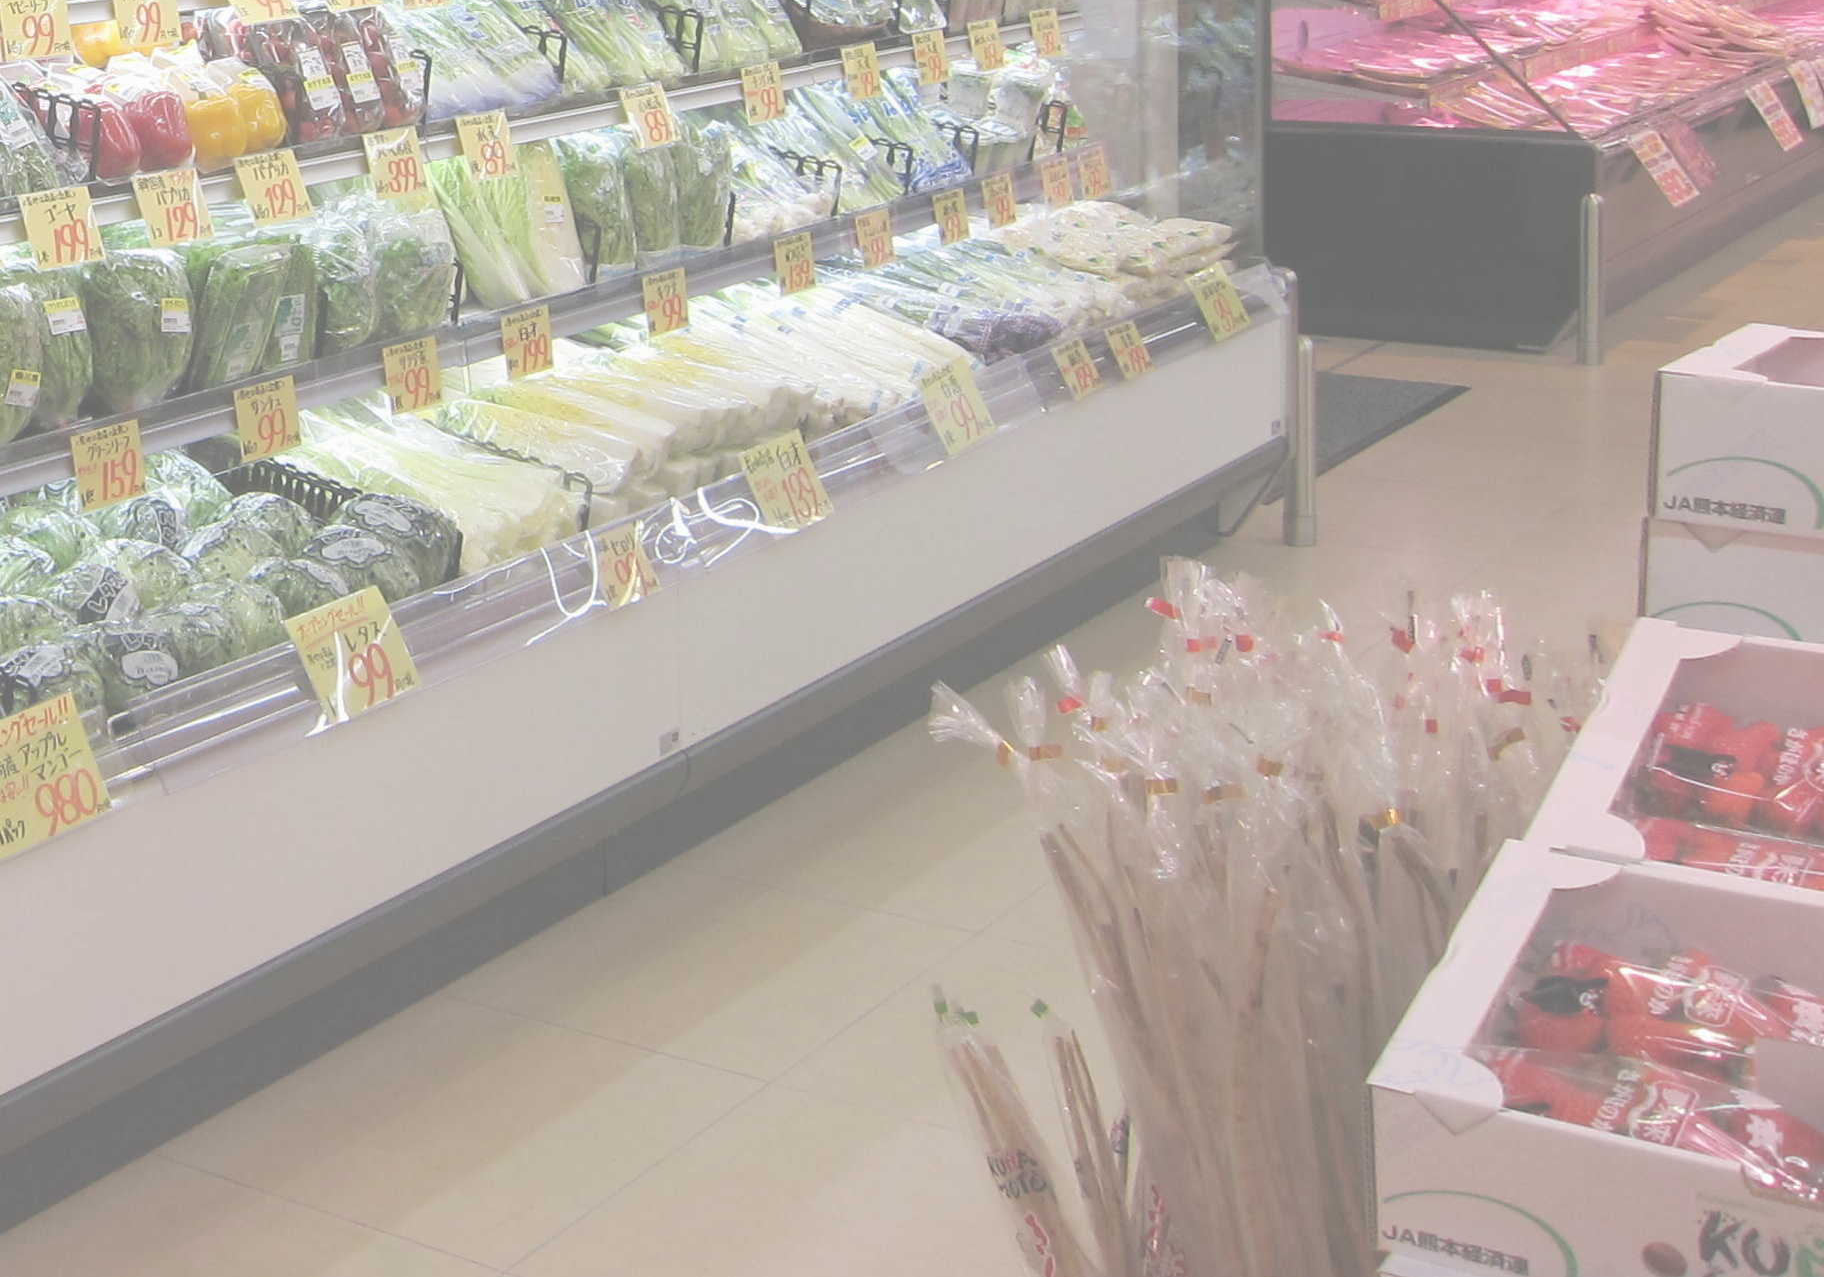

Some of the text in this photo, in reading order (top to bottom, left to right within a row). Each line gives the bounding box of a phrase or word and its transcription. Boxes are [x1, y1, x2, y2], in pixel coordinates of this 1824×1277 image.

[22, 13, 55, 55] 99
[137, 2, 162, 42] 99
[644, 109, 671, 143] 89
[388, 157, 417, 192] 399
[481, 141, 505, 174] 89
[265, 178, 296, 217] 129
[53, 218, 91, 262] 199
[164, 201, 198, 242] 129
[662, 294, 682, 331] 99
[523, 333, 547, 372] 199
[405, 366, 430, 408] 99
[257, 407, 286, 454] 99
[951, 393, 982, 440] 99
[102, 448, 138, 500] 159
[782, 467, 819, 524] 139
[1664, 494, 1787, 526] JA熊本経済連
[348, 643, 394, 707] 99
[19, 731, 67, 767] アップル
[31, 749, 82, 781] マンゴー
[34, 769, 98, 837] 980
[1382, 1225, 1530, 1275] JA熊本経済連
